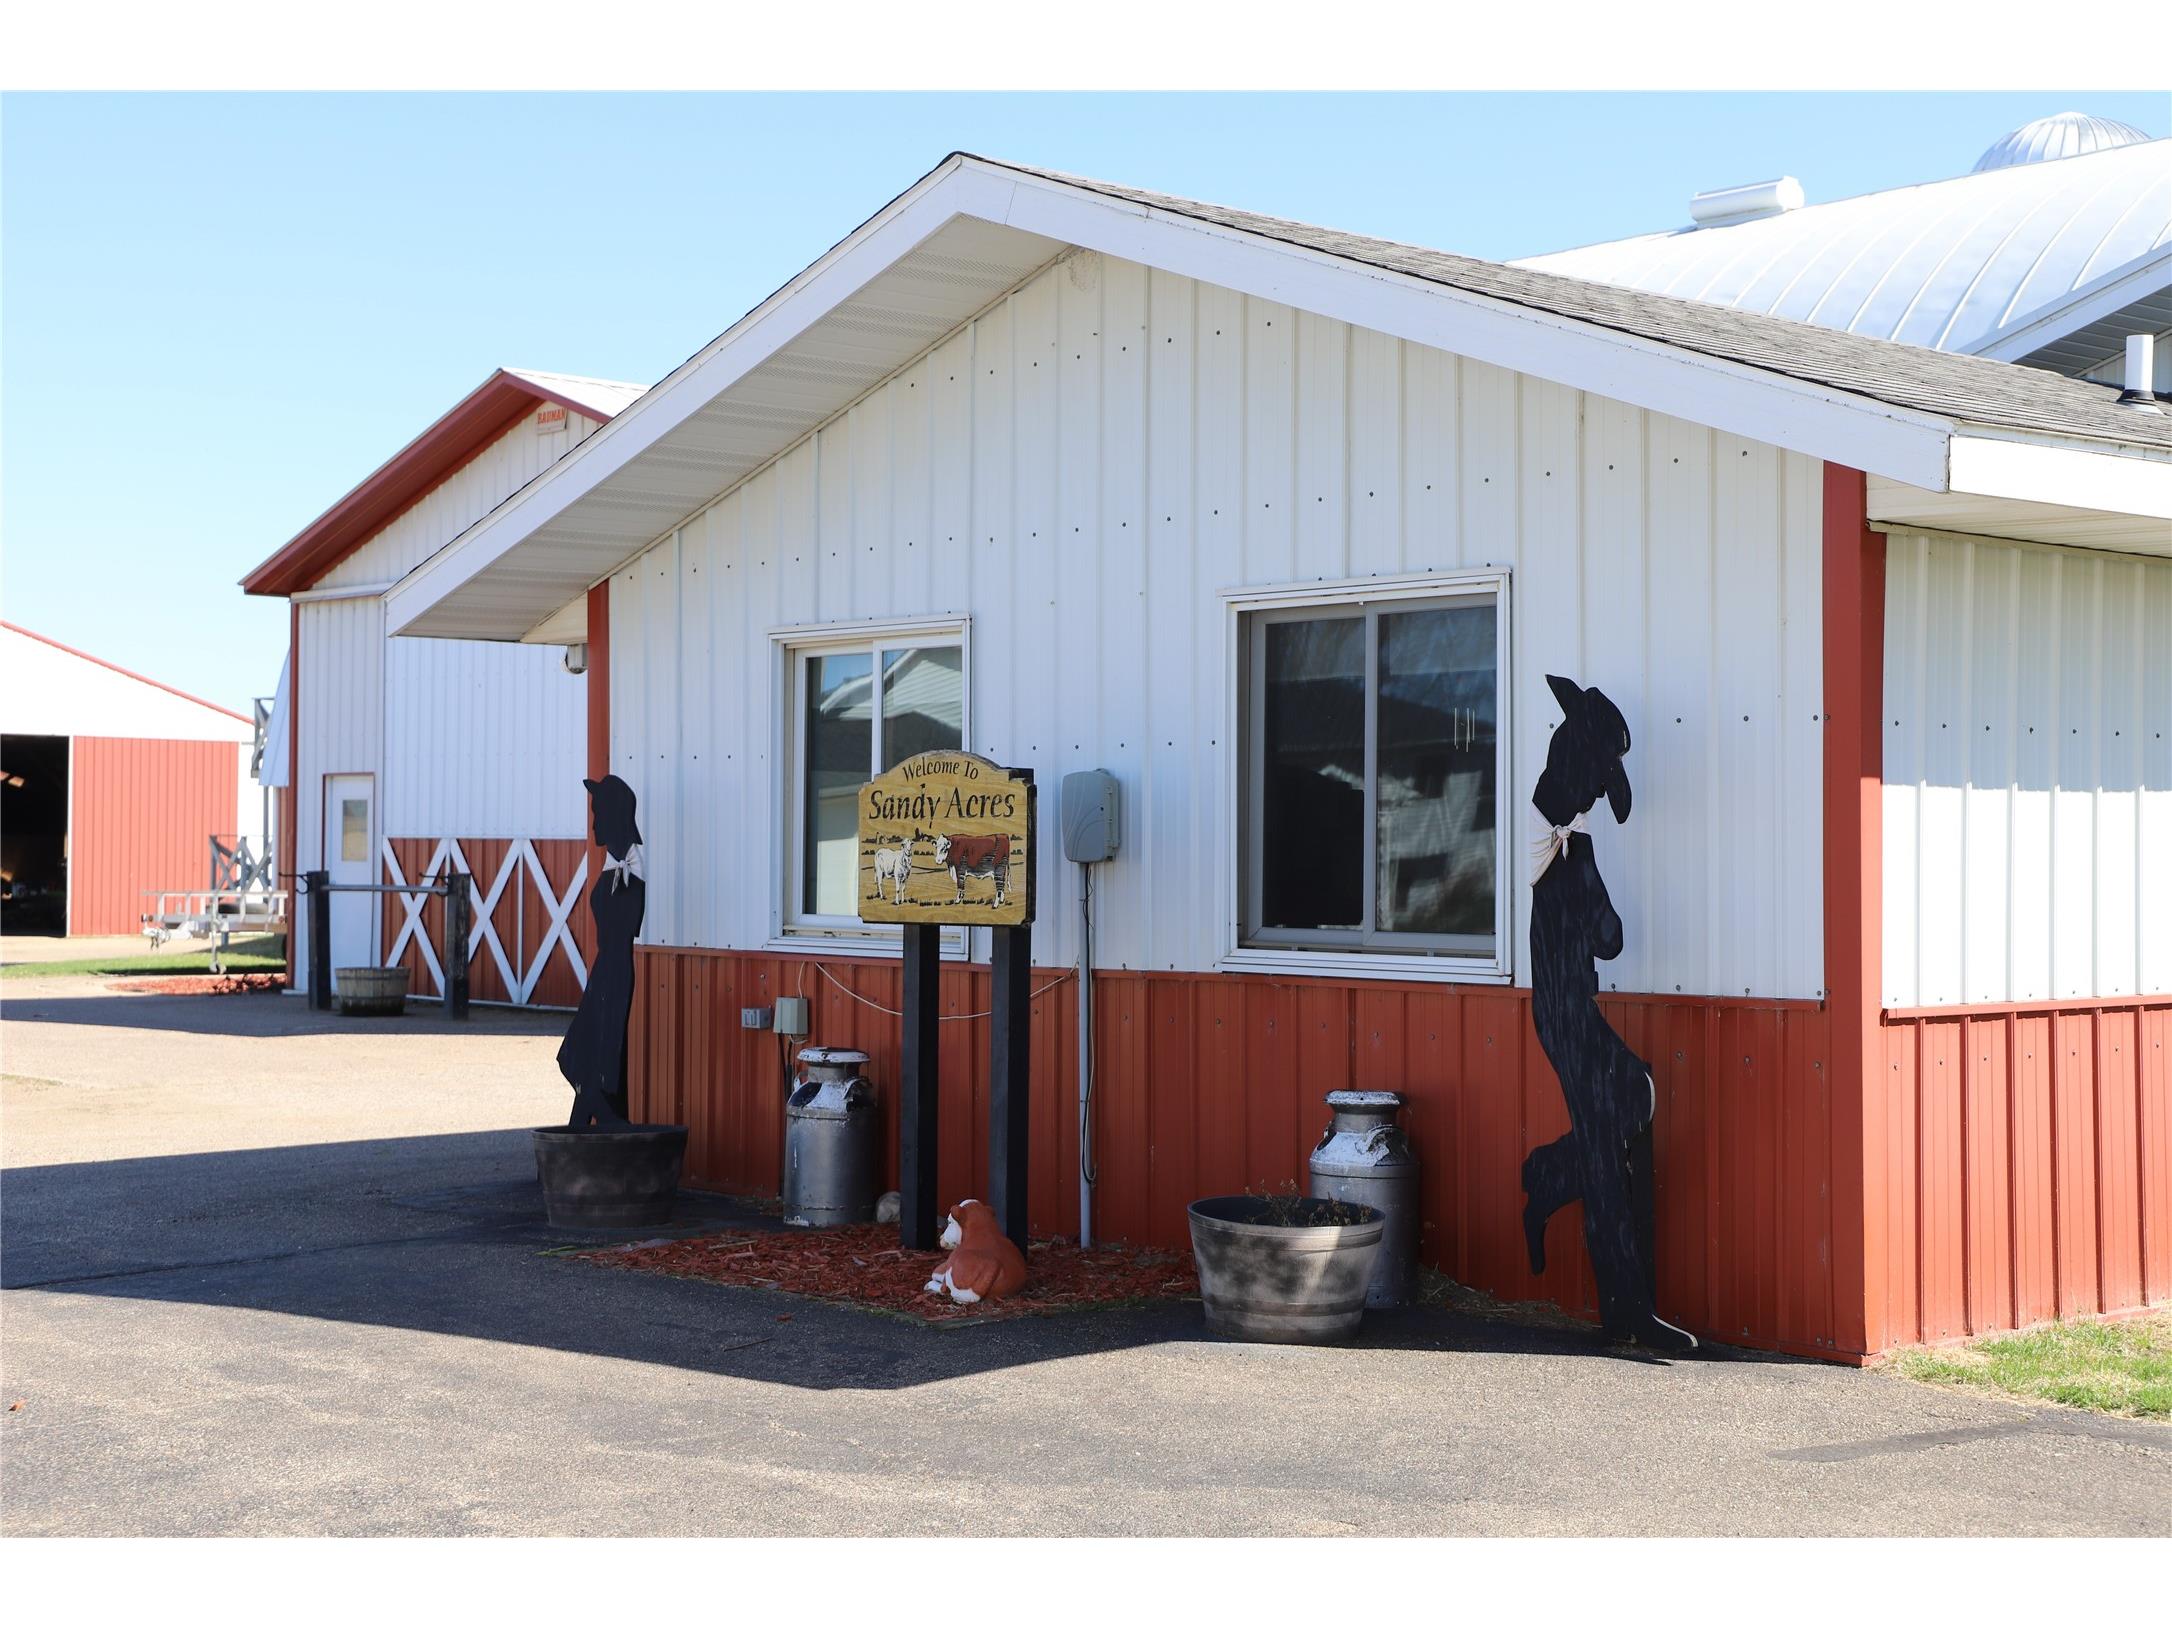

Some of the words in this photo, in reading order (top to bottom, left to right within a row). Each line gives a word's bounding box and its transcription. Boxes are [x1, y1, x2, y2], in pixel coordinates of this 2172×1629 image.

[902, 757, 960, 782] Welcome
[964, 760, 979, 780] To
[868, 783, 941, 829] Sandy
[944, 787, 1016, 819] Acres
